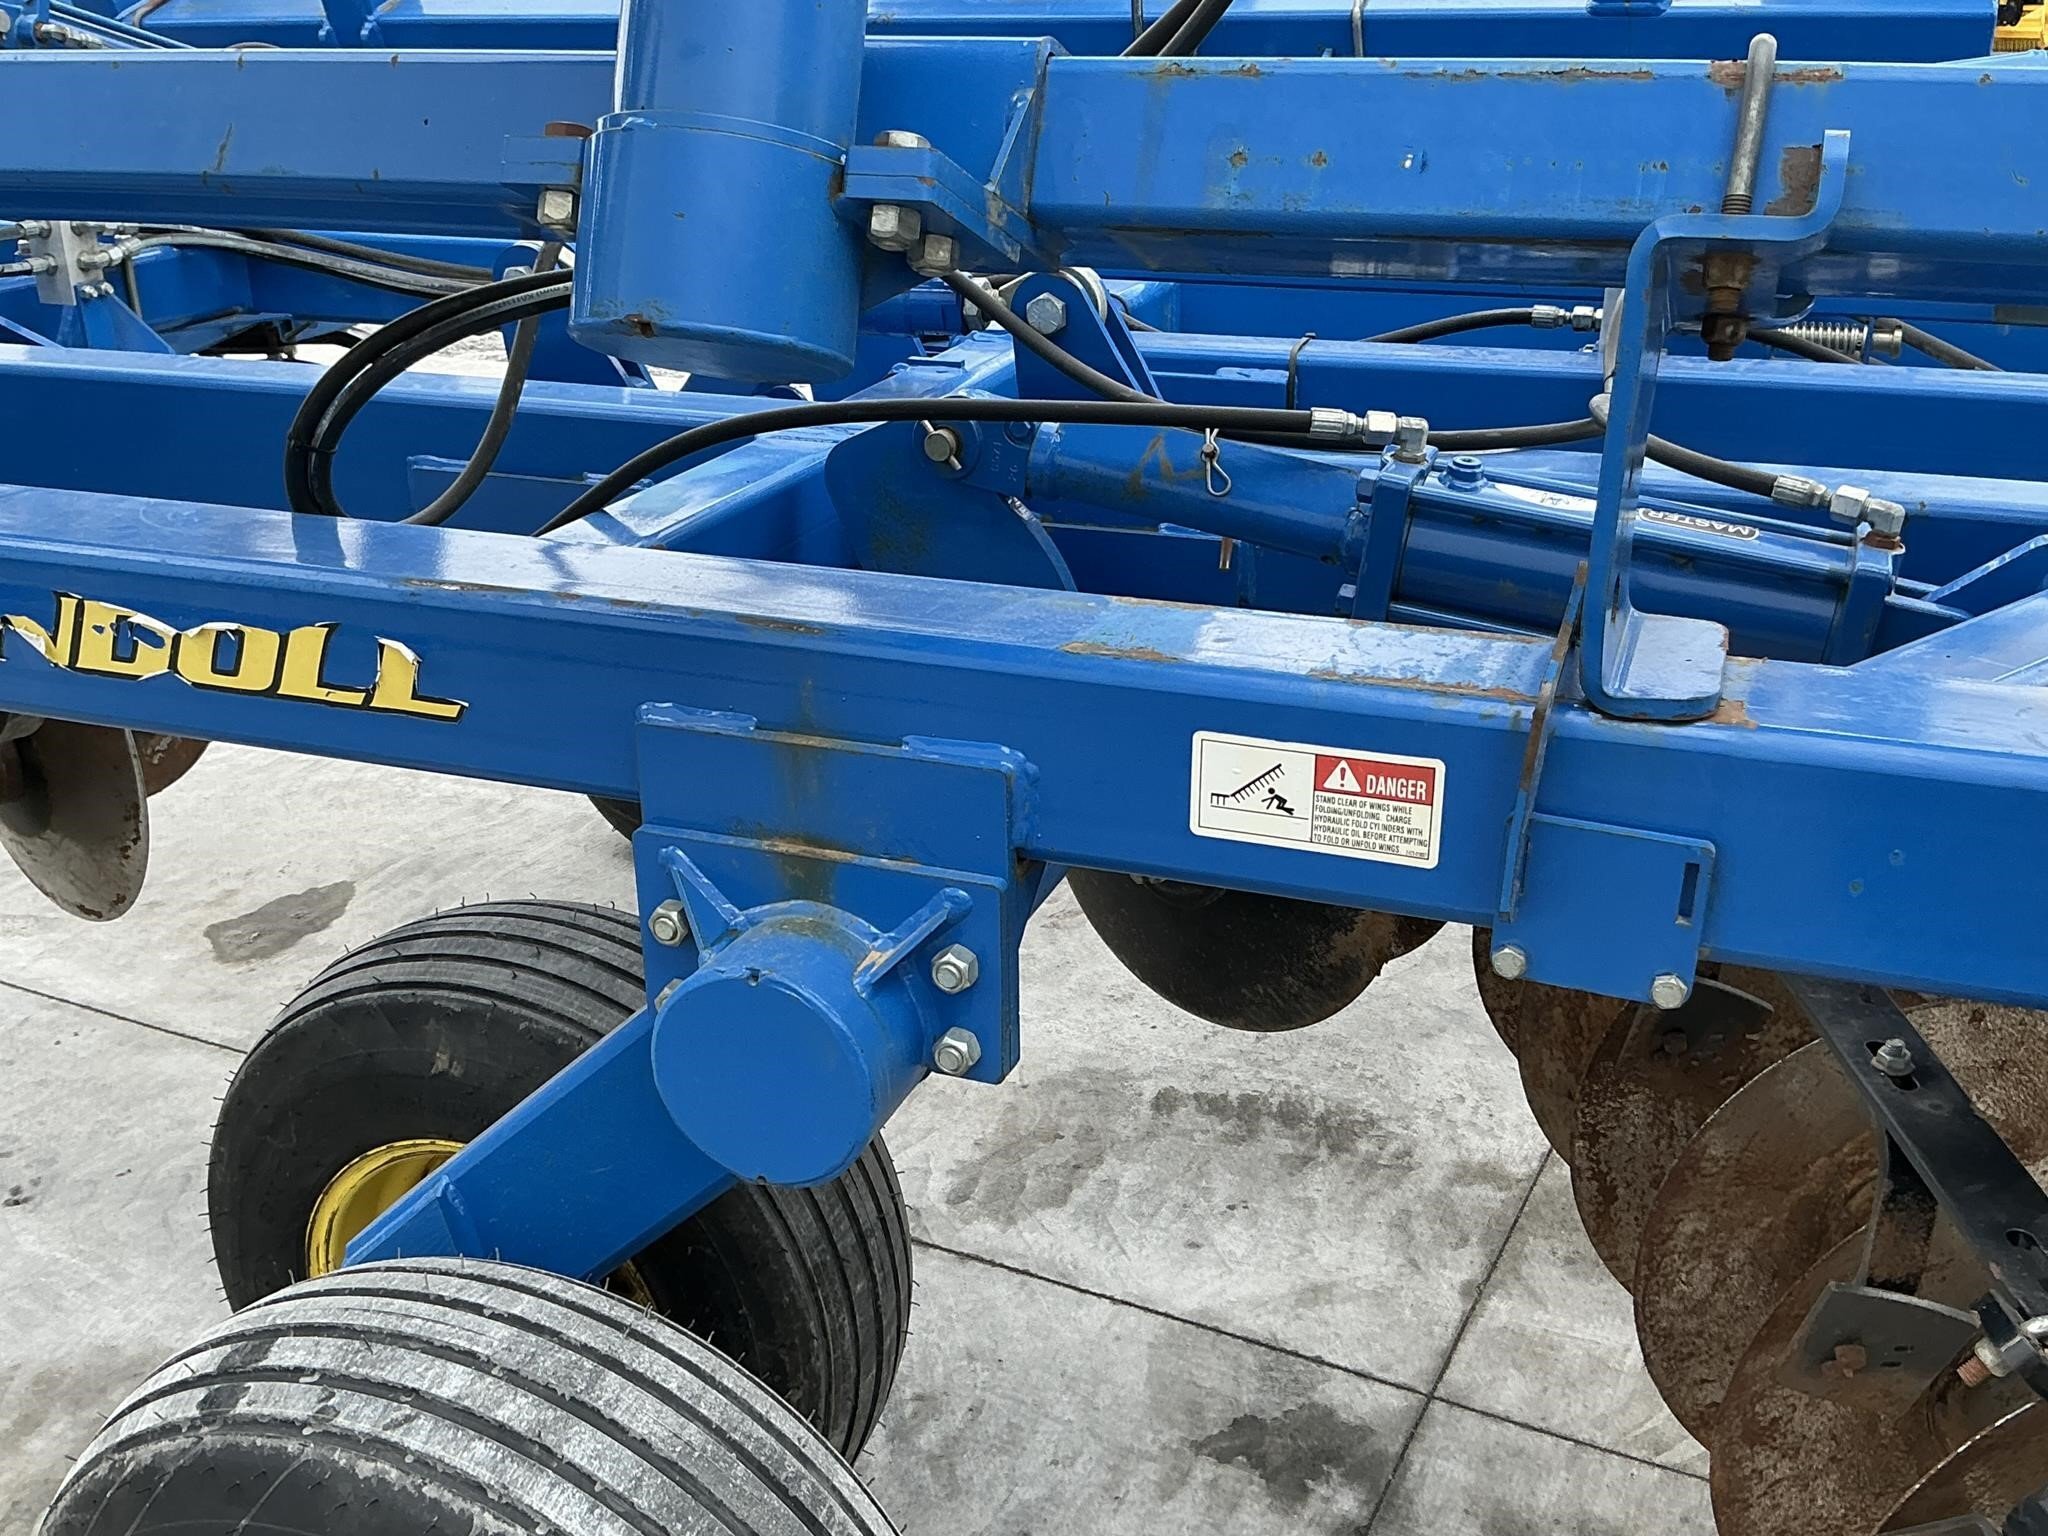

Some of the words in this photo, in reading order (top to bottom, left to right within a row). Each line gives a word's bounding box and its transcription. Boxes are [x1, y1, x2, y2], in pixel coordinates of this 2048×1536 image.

[1648, 509, 1749, 536] MASTER
[1365, 774, 1427, 801] DANGER
[1315, 794, 1336, 804] STAND
[1337, 797, 1357, 807] CLEAR
[1358, 800, 1367, 809] OF
[1369, 801, 1390, 812] WINGS
[1392, 805, 1413, 815] WHILE
[1314, 814, 1350, 827] HYDRAULIC
[1351, 819, 1368, 829] FOLD
[1406, 826, 1423, 837] WITH
[1385, 814, 1412, 825] CHARGE
[1313, 824, 1350, 837] HYDRAULIC
[1351, 828, 1361, 838] OIL
[1363, 830, 1386, 841] BEFORE
[1388, 833, 1428, 848] ATTEMPTING
[1313, 833, 1322, 842] TO
[1323, 834, 1340, 844] FOLD
[1341, 837, 1350, 846] OR
[1351, 839, 1377, 850] UNFOLD
